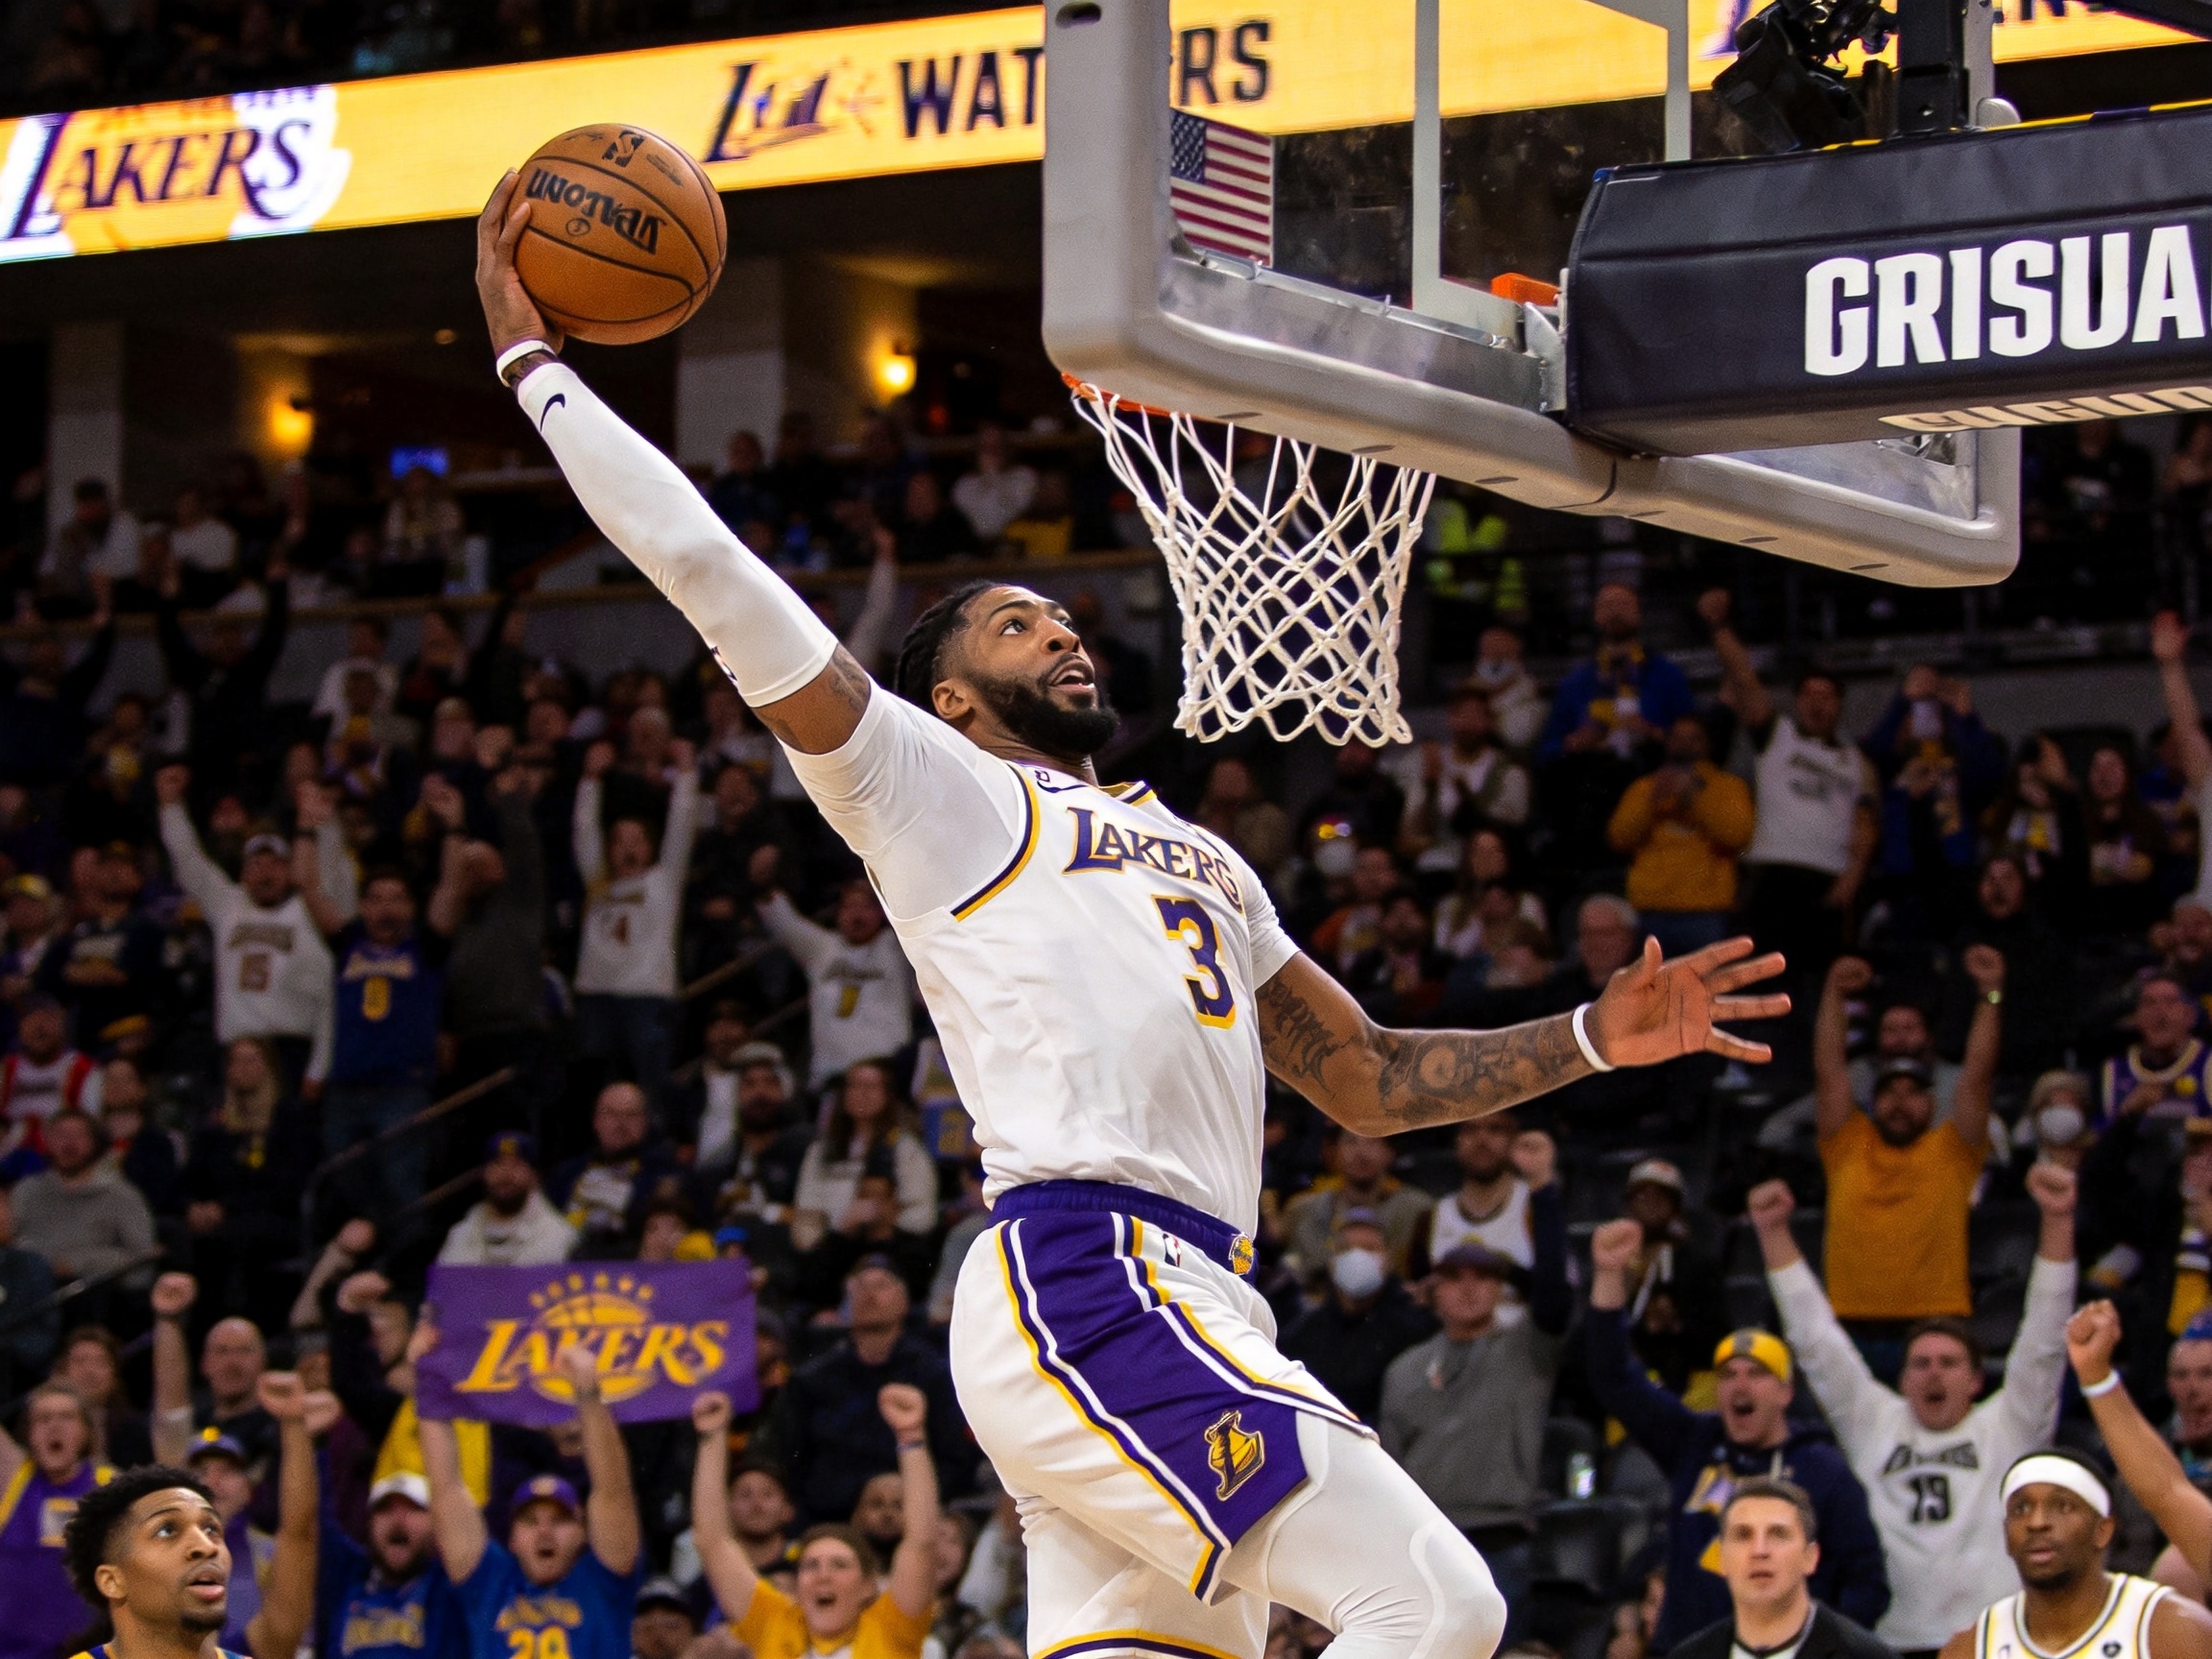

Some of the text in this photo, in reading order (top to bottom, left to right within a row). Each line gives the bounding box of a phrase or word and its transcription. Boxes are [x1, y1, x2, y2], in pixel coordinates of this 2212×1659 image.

[5, 122, 312, 239] LAKERS
[1804, 224, 2212, 376] GRISUA
[1150, 893, 1237, 1030] 3
